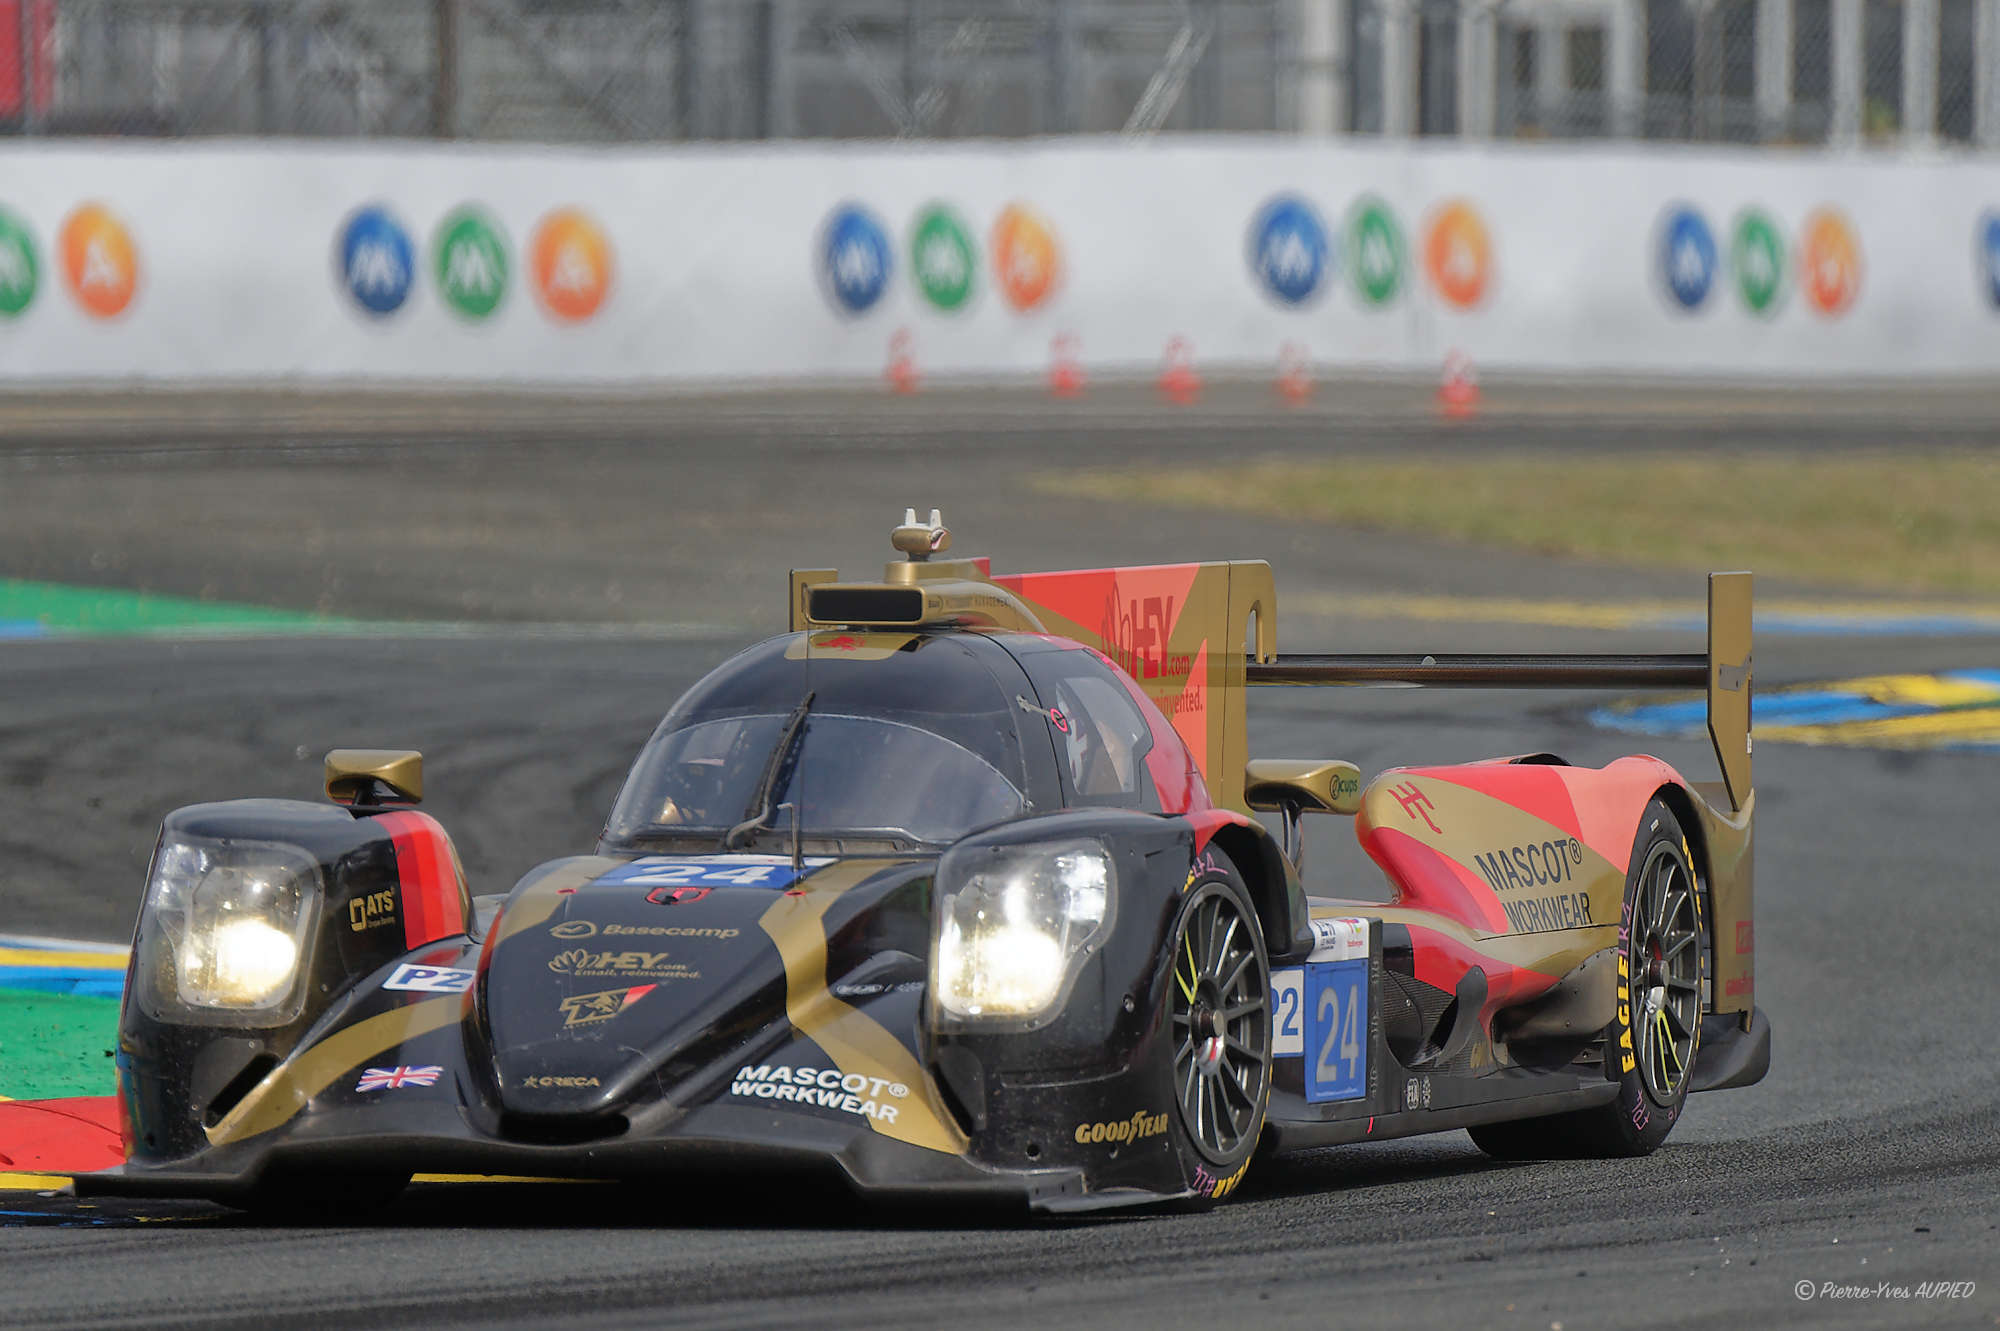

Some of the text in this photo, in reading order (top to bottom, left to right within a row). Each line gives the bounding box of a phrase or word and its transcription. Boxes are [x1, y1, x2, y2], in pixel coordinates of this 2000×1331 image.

[623, 865, 776, 885] 24
[603, 924, 740, 939] Basecamp
[1502, 892, 1593, 934] WORKWEAR
[396, 968, 473, 988] P2
[1316, 984, 1360, 1084] 24
[1617, 955, 1636, 1075] EAGLE
[731, 1081, 899, 1125] WORKWEAR
[1074, 1110, 1169, 1145] GOODYEAR
